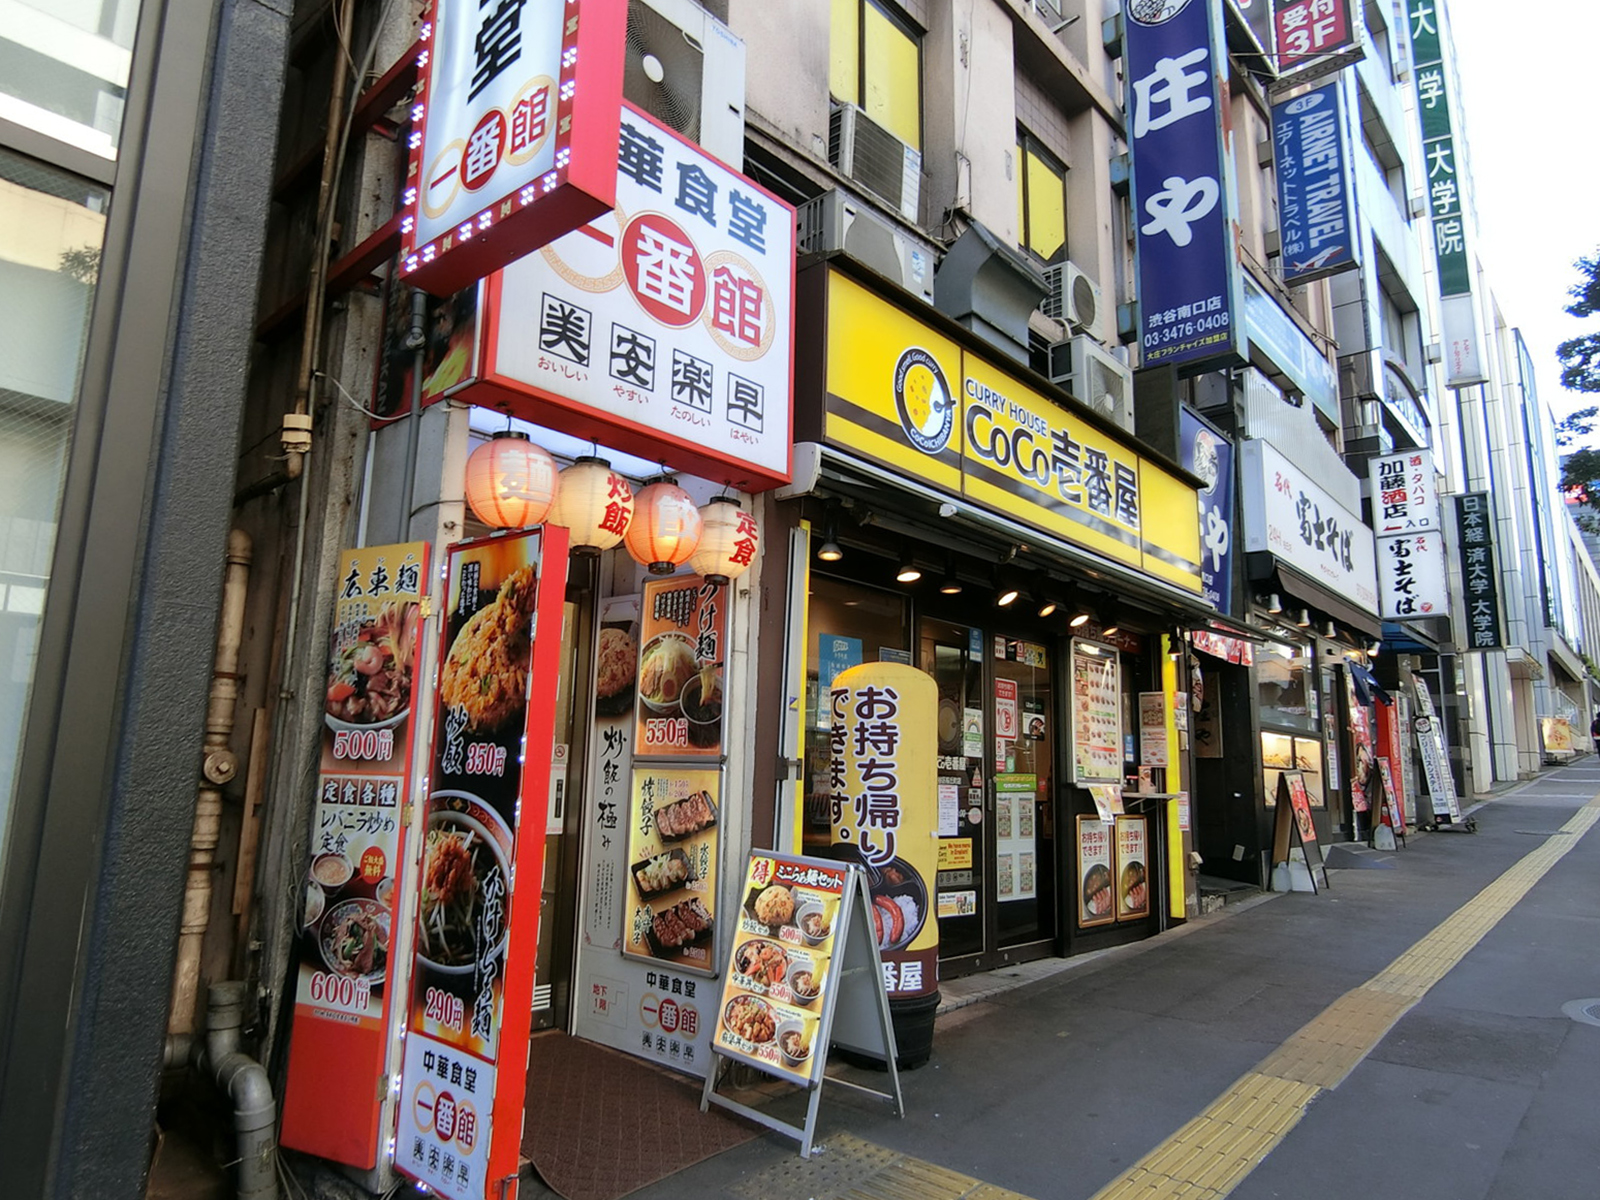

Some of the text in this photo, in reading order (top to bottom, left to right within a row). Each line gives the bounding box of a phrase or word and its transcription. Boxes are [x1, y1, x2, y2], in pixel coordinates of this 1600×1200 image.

[1285, 16, 1336, 58] 3F
[1296, 96, 1313, 111] 3F
[429, 85, 549, 191] 一番館
[1133, 48, 1219, 248] 庄や
[1300, 110, 1345, 248] AIRNET TRAVEL
[1427, 144, 1463, 256] 大学院
[1144, 312, 1229, 348] 03-3476-0408
[1149, 295, 1222, 328] 渋谷南口店
[1147, 331, 1228, 361] 大庄フランチャイズ加盟店
[538, 356, 759, 445] おいしい やすい たのしい はやい
[965, 377, 1048, 438] CURRY HOUSE
[965, 404, 1141, 532] CoCo壱番屋
[598, 472, 633, 536] 炒飯
[1378, 460, 1408, 520] 加藤酒店
[728, 510, 758, 567] 定食
[1295, 489, 1354, 573] 富士そば
[1405, 517, 1430, 528] 入口
[340, 564, 420, 600] 広東麺
[1389, 538, 1420, 616] 富士そば
[1463, 496, 1495, 648] 日本経済大学 大学院
[694, 582, 719, 661] つけ麺
[333, 730, 393, 759] 500円
[646, 719, 688, 748] 550円
[465, 742, 506, 778] 350円
[831, 687, 850, 841] できます。
[854, 685, 900, 867] お持ち帰り
[322, 780, 398, 807] 定食各種
[597, 725, 627, 851] 炒飯の極み
[640, 777, 655, 836] 焼餃子
[319, 833, 349, 854] 定食
[320, 809, 396, 835] レバニラ炒め
[364, 866, 382, 878] 無料
[752, 860, 770, 885] 得
[310, 970, 370, 1011] 600円
[592, 983, 608, 997] 地下
[646, 971, 696, 999] 中華食堂
[769, 983, 792, 1002] 550円
[425, 986, 464, 1033] 290円
[643, 1002, 697, 1035] 一番館
[423, 1050, 478, 1094] 中華食堂
[758, 1045, 781, 1063] 550円
[417, 1096, 476, 1148] 一番館
